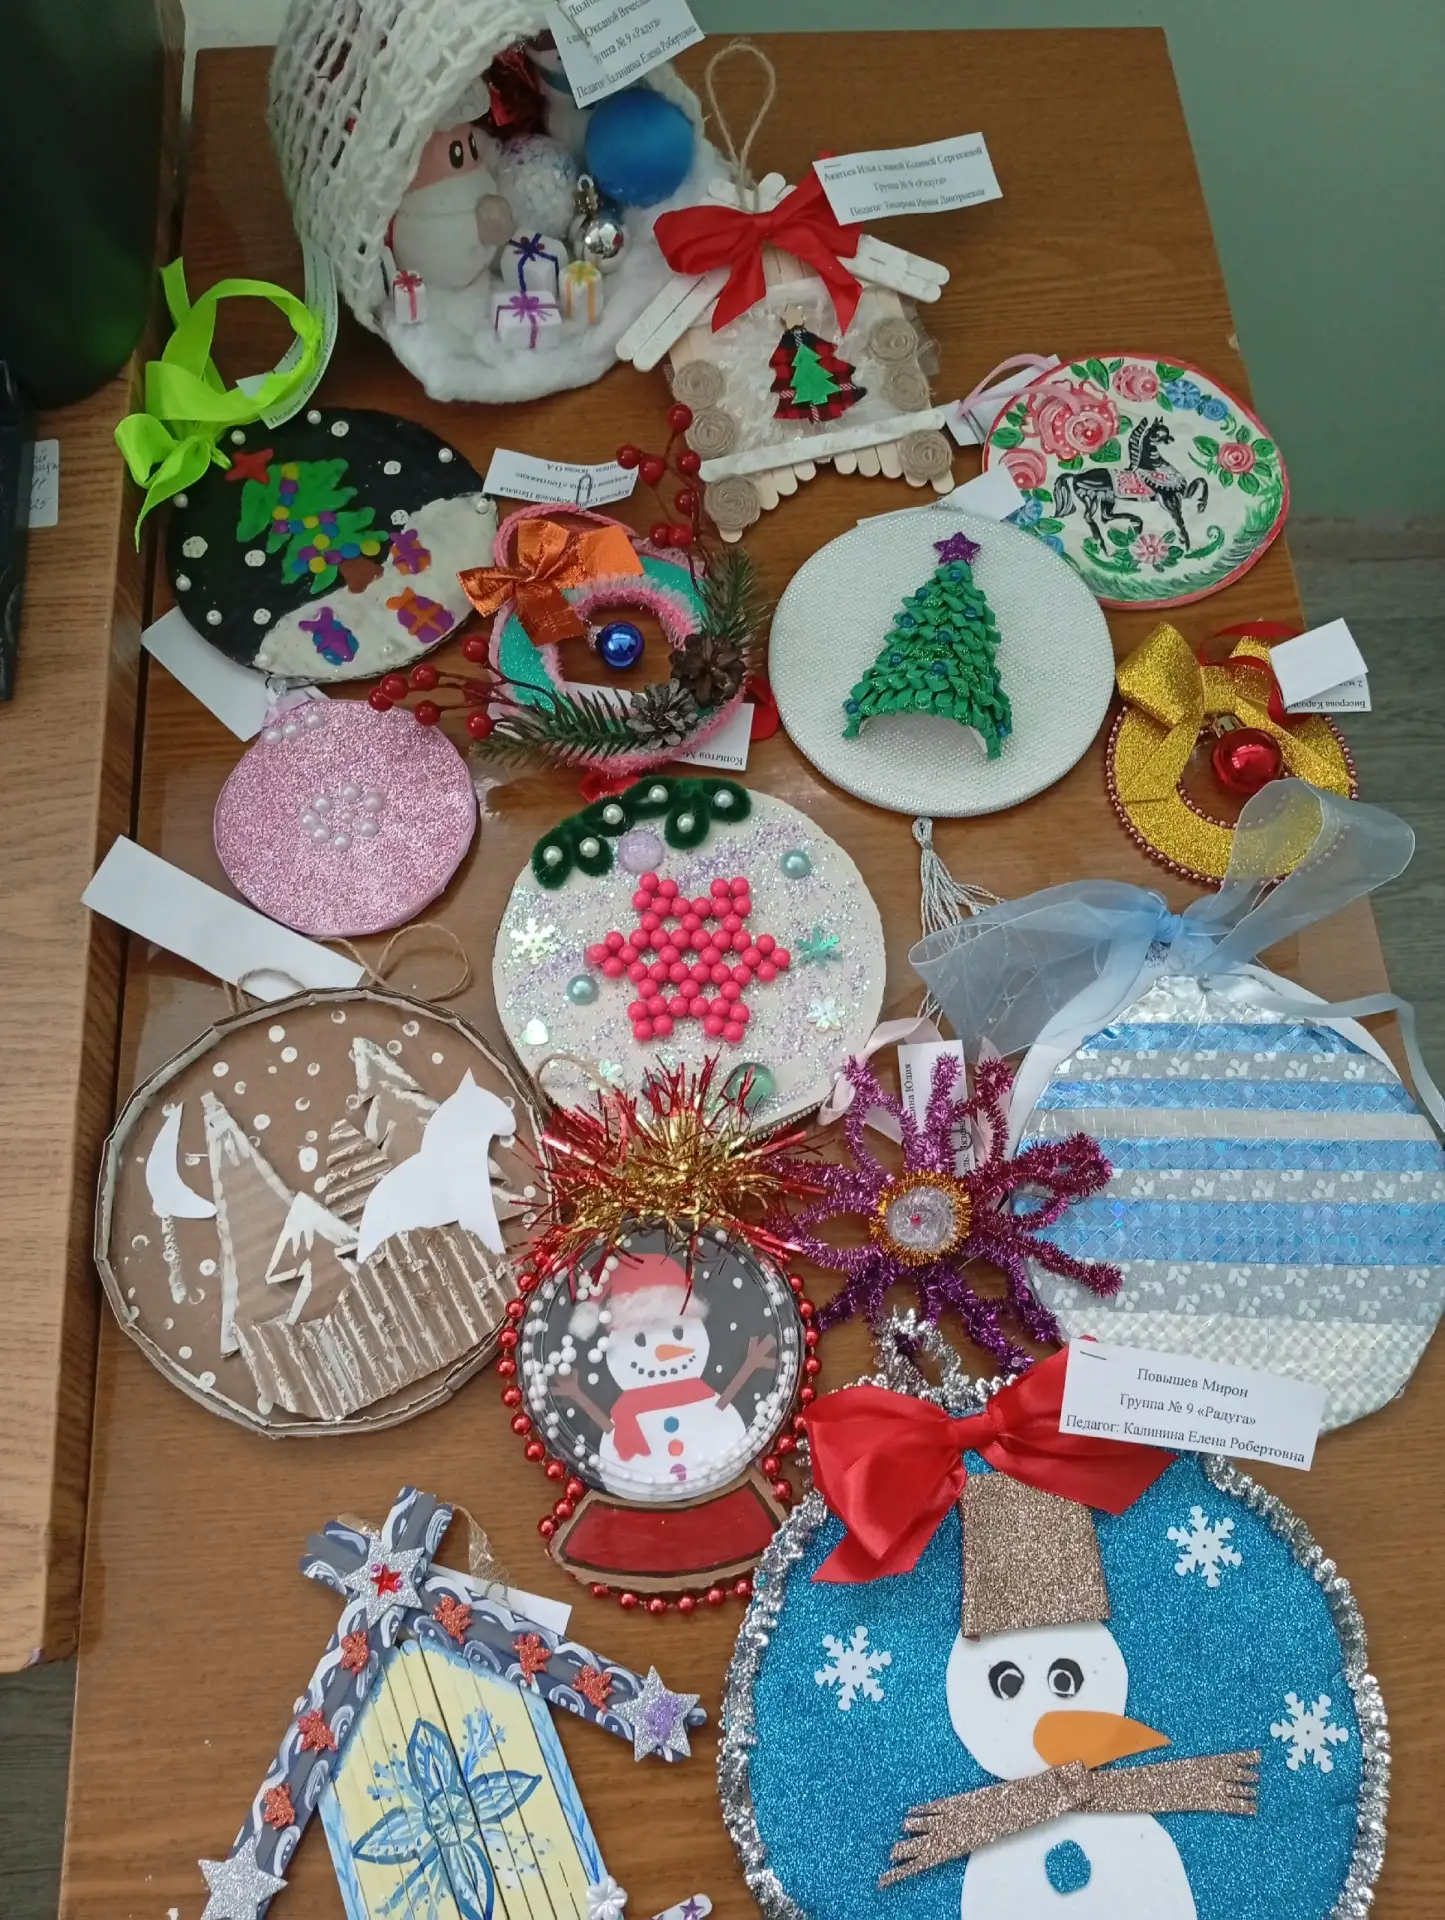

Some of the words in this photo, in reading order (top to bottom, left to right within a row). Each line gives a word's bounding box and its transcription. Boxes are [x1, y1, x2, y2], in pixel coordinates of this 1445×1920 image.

[585, 10, 620, 37] Оксаной
[625, 31, 632, 43] 9
[640, 48, 662, 65] Елена
[936, 146, 983, 165] Сергеевной
[873, 181, 900, 193] Группа
[904, 1063, 914, 1093] Юлия
[1136, 1367, 1199, 1389] Повышев
[1202, 1377, 1249, 1399] Мирон
[1119, 1392, 1165, 1413] Группа
[1167, 1400, 1183, 1414] №
[1186, 1402, 1195, 1415] 9
[1197, 1405, 1257, 1427] «Радуга»
[1066, 1414, 1121, 1434] Педагог:
[1123, 1421, 1185, 1443] Калинина
[1188, 1430, 1227, 1448] Елена
[1229, 1436, 1305, 1464] Робертовна
